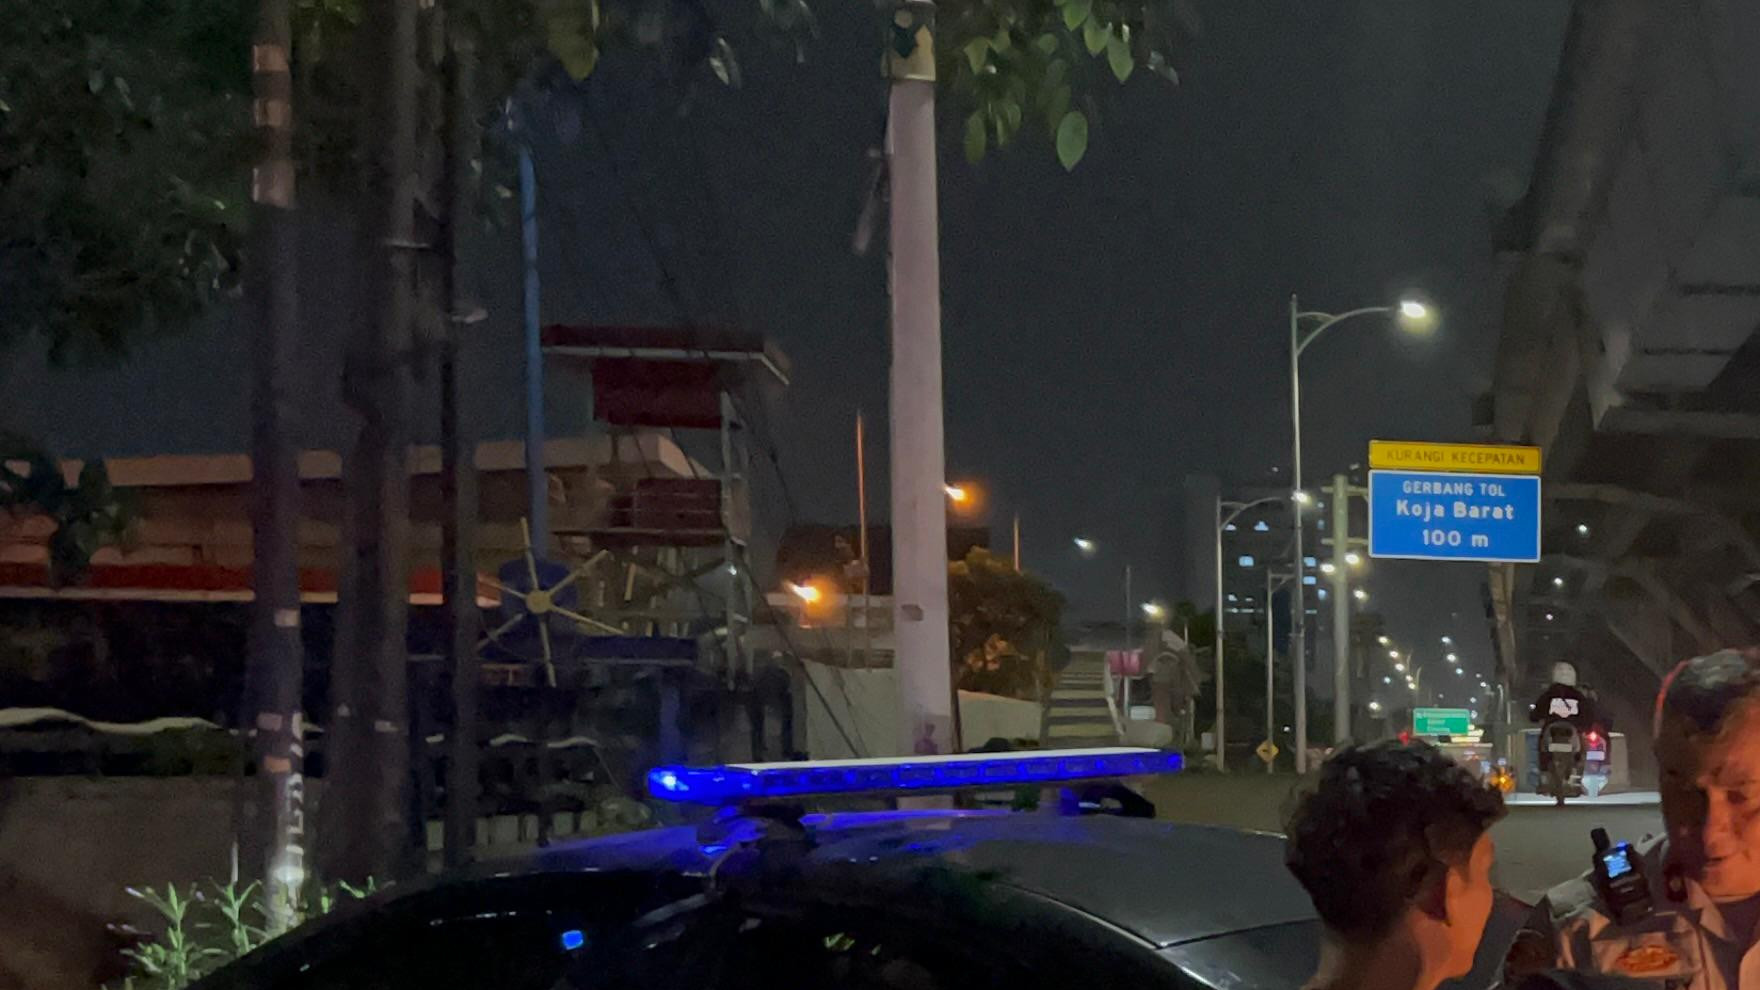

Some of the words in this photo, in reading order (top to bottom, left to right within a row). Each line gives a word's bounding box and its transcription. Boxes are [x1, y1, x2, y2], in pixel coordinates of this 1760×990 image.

[1386, 450, 1444, 463] KURANGI
[1452, 451, 1526, 465] KECEPATAN
[1402, 480, 1474, 496] GERBANG
[1480, 483, 1506, 497] TOL
[1396, 499, 1445, 522] Koja
[1453, 501, 1515, 520] Barat
[1422, 529, 1461, 546] 100
[1471, 534, 1489, 548] m
